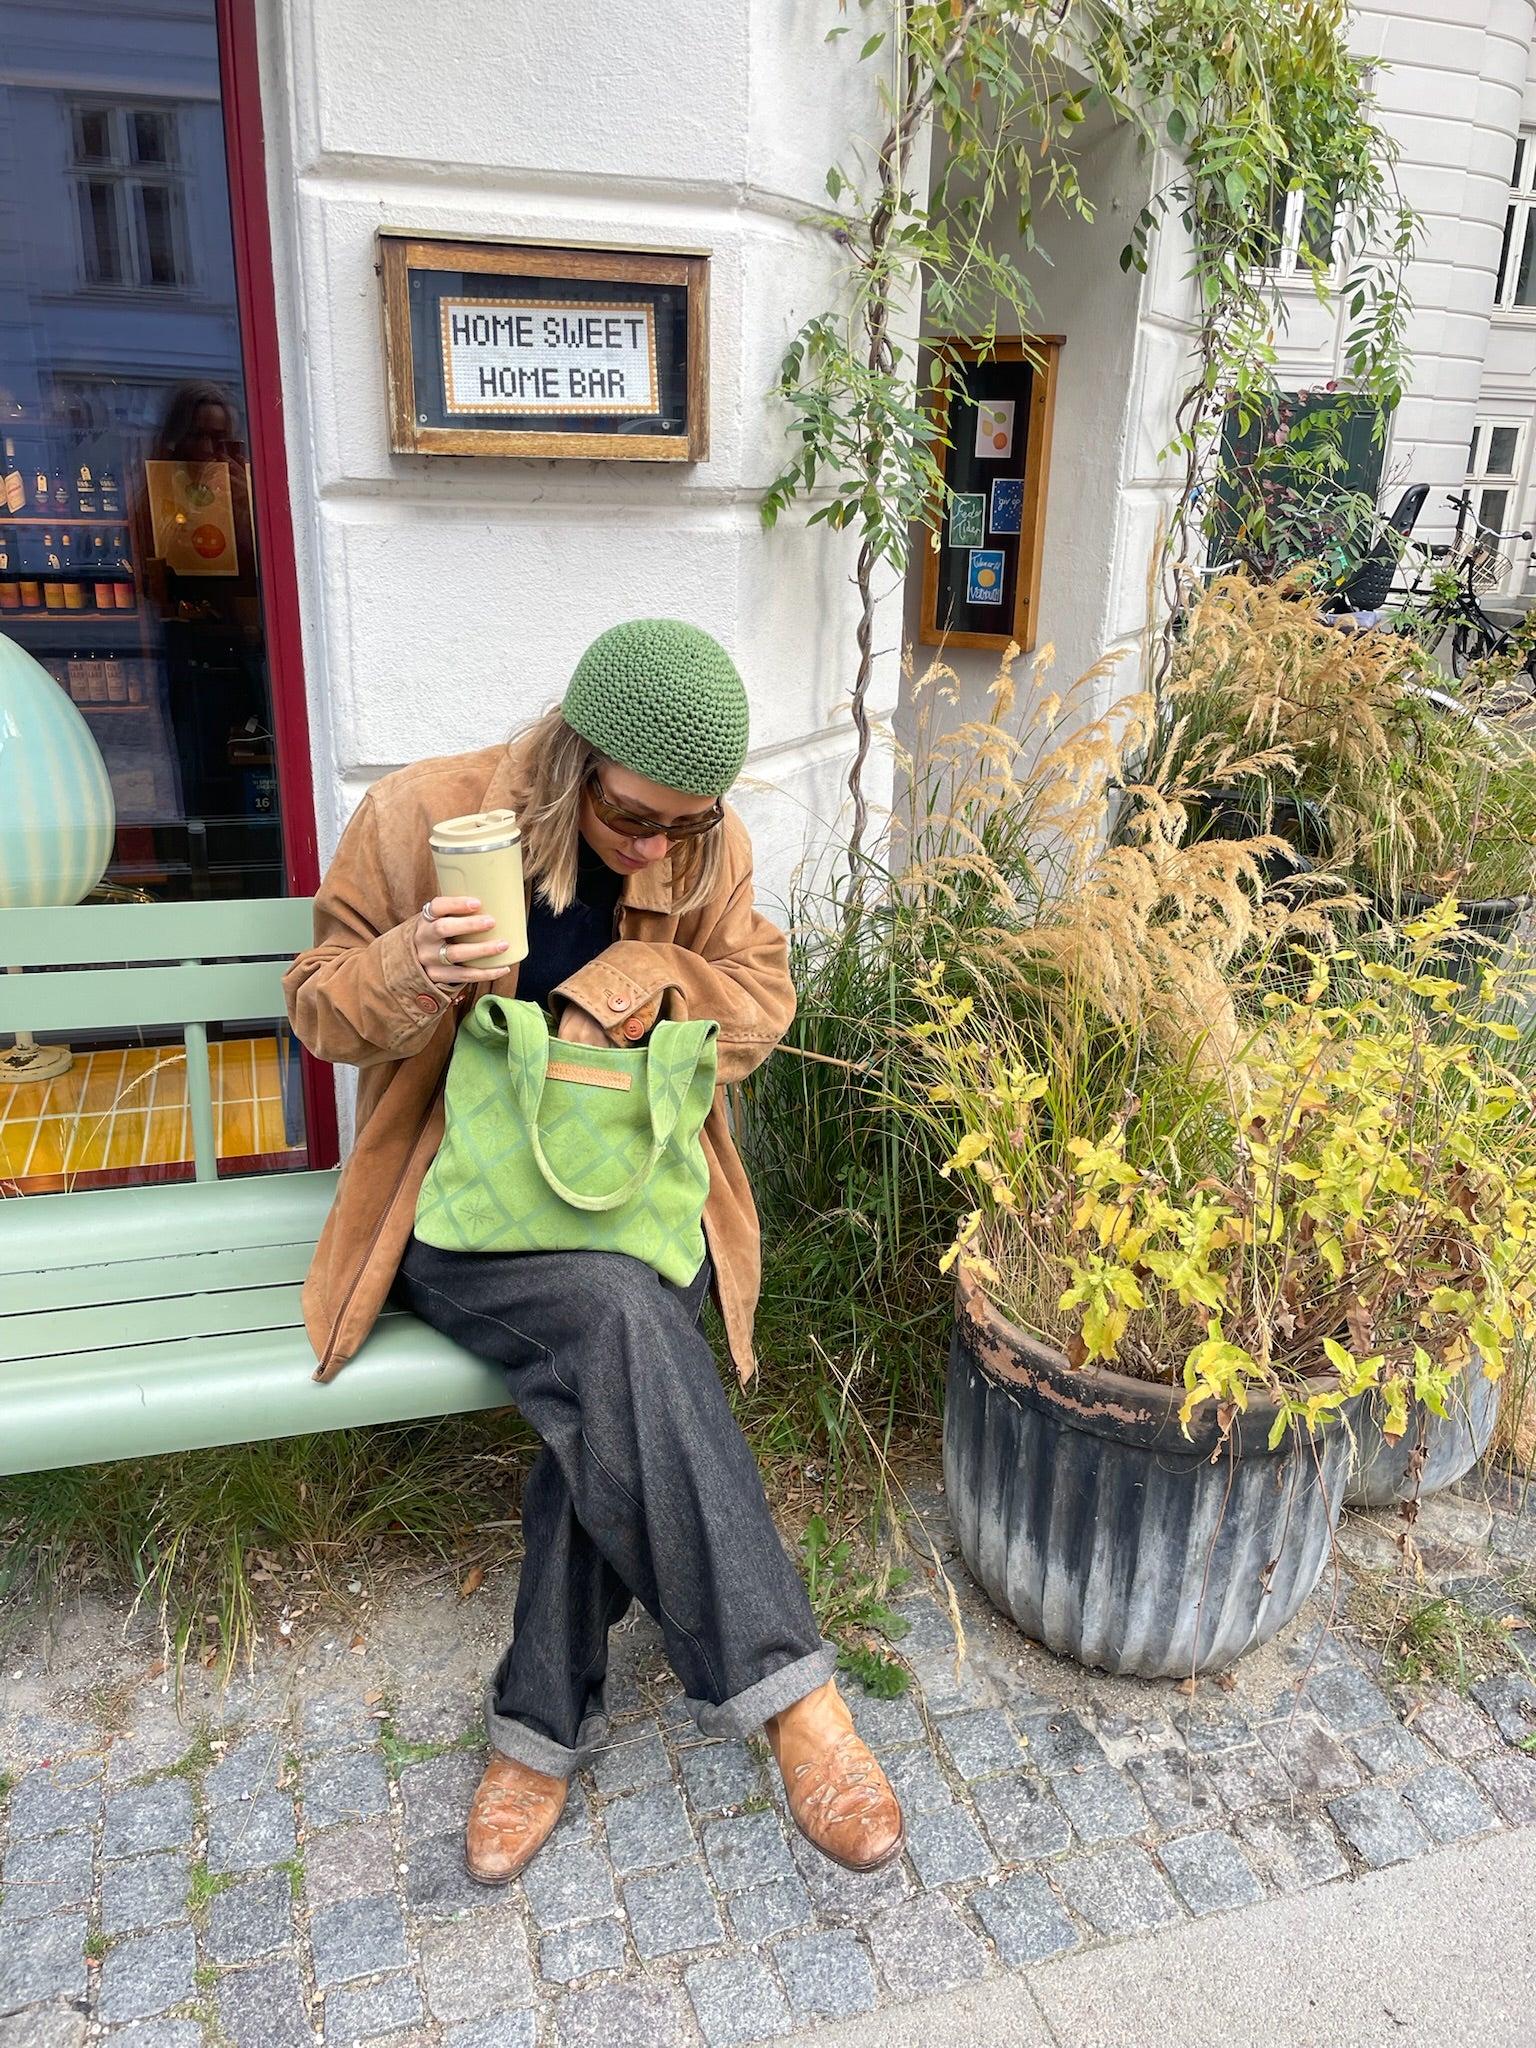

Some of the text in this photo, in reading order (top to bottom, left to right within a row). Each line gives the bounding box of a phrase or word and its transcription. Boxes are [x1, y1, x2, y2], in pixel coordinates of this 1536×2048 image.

[452, 314, 644, 349] HOME SWEET
[479, 366, 625, 398] HOME BAR
[255, 797, 270, 808] 16
